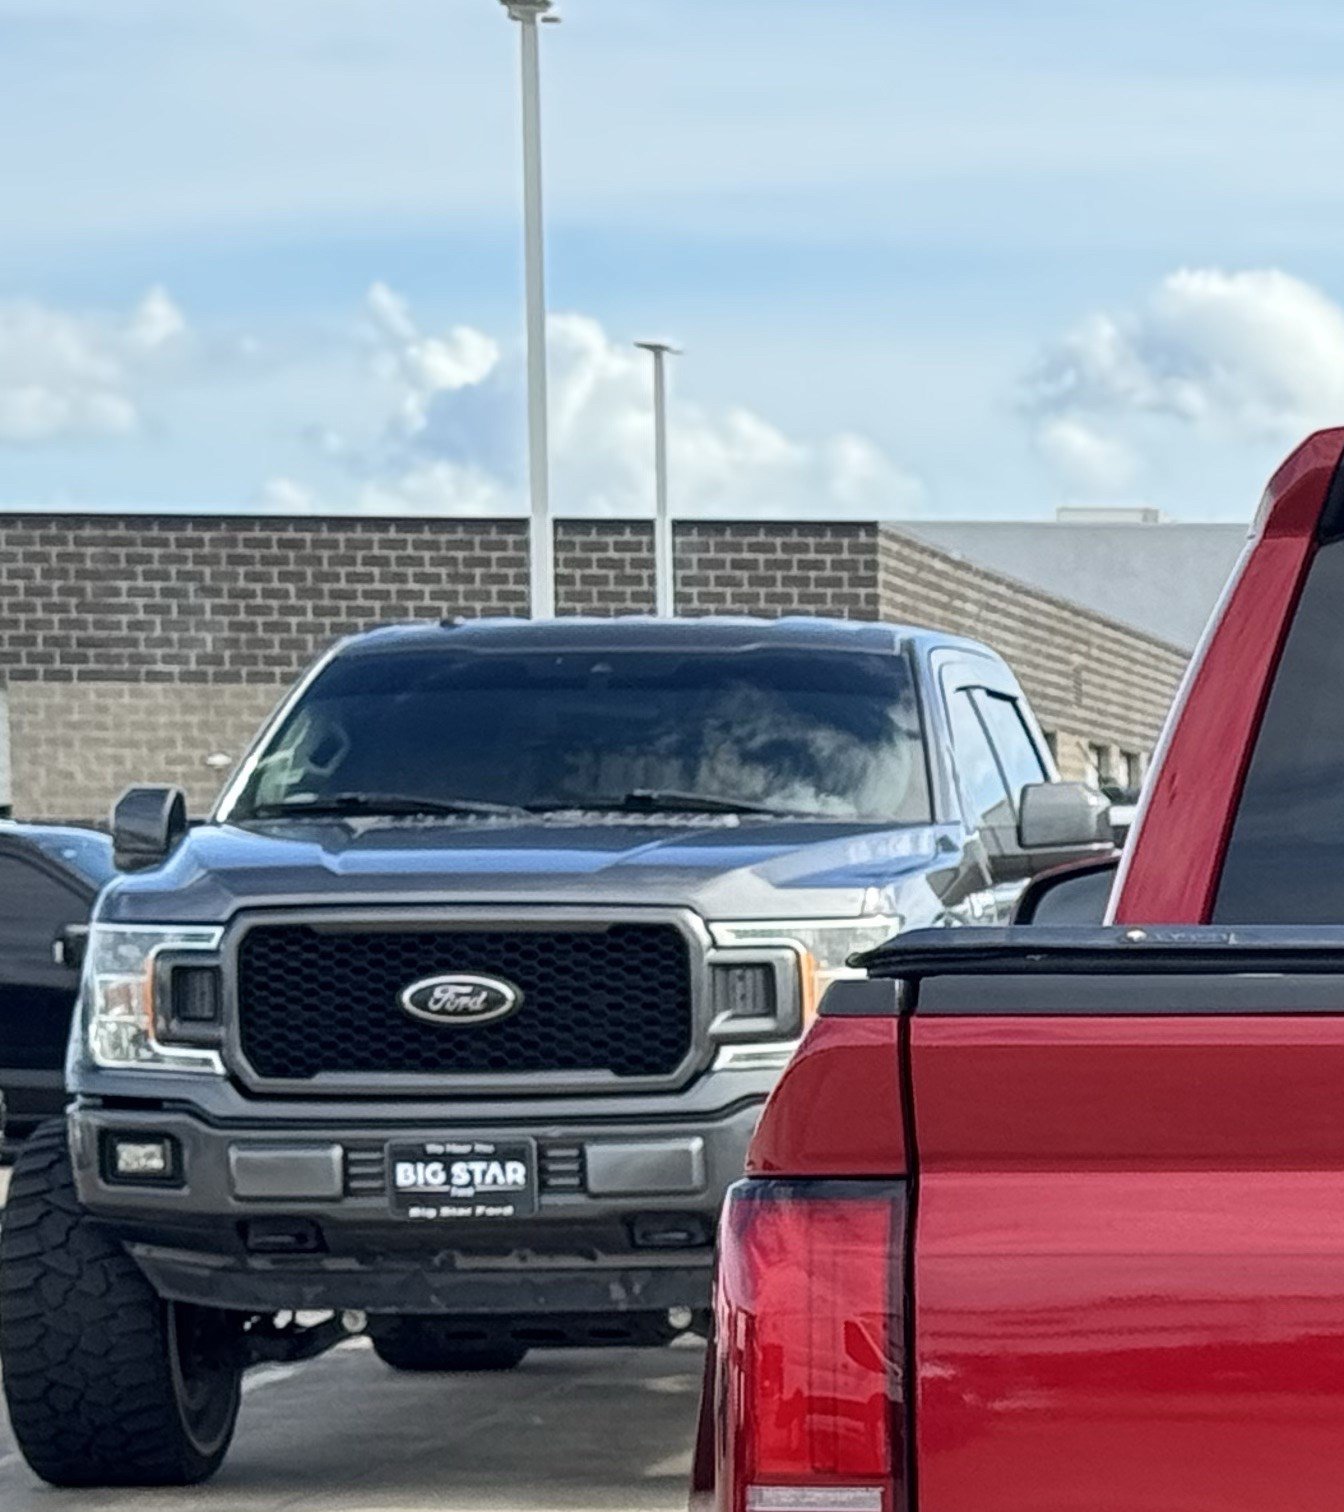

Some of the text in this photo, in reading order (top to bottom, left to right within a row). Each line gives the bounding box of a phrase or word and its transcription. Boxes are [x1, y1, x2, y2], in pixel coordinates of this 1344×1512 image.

[427, 984, 489, 1012] Ford
[396, 1161, 527, 1187] BIG STAR
